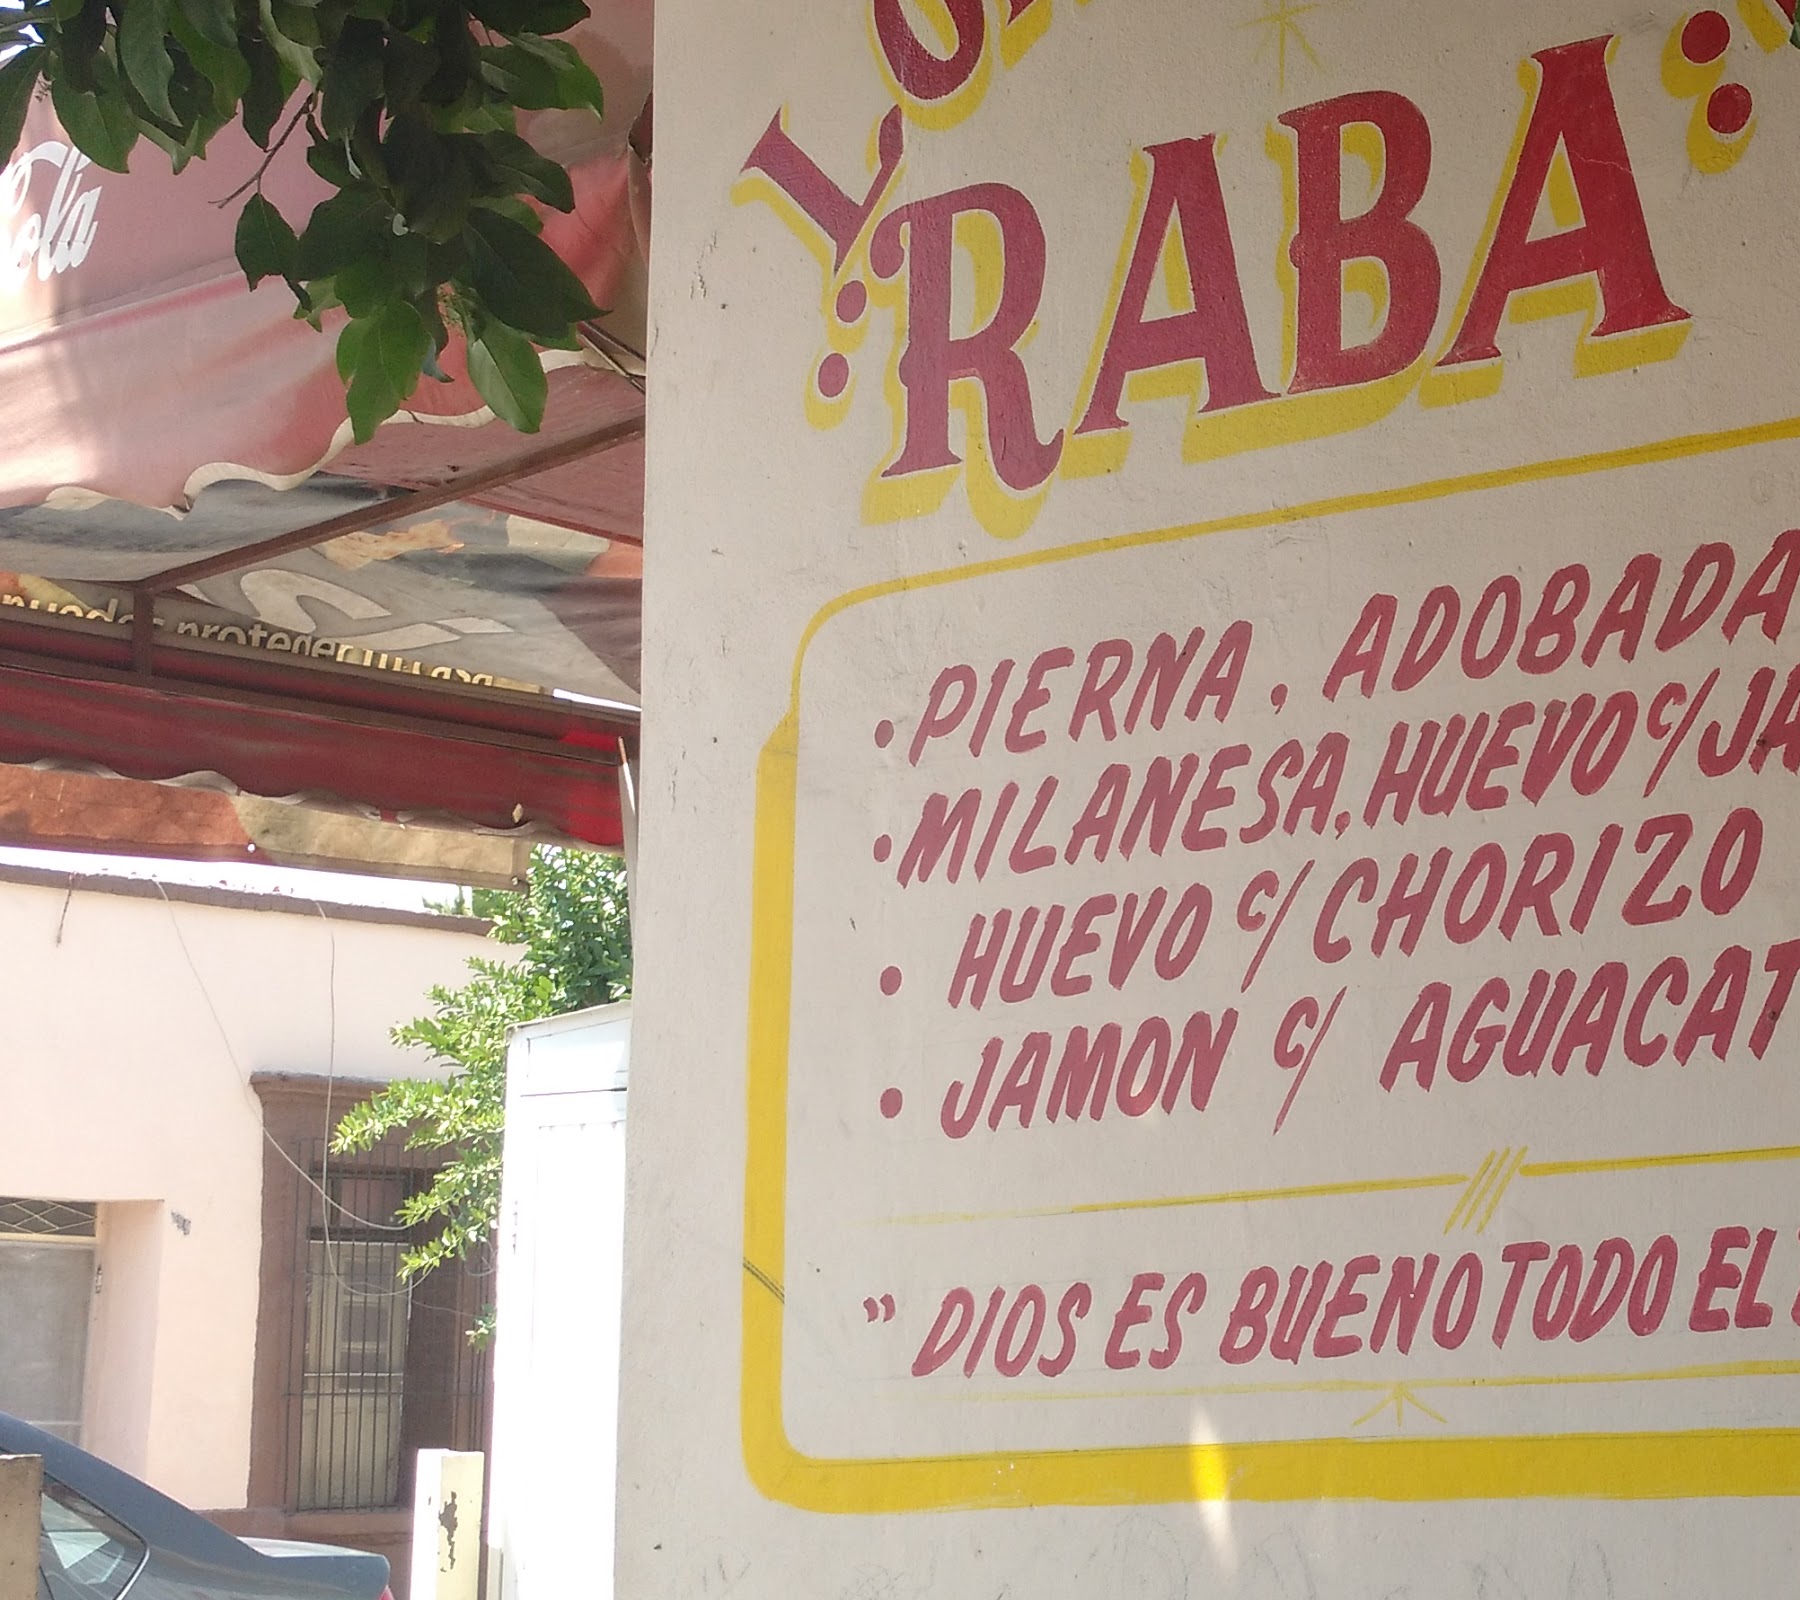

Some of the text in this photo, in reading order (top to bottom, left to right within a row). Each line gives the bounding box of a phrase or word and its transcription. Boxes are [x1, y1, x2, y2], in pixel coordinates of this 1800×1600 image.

[870, 34, 1692, 491] RABA
[1364, 691, 1636, 829] HUEVO
[948, 883, 1212, 1010] HUEVO
[1312, 807, 1763, 963] CHORIZO
[940, 1008, 1238, 1138] JAMON
[1105, 1272, 1207, 1370] ES
[1220, 1252, 1483, 1364] BUENO
[1492, 1235, 1678, 1350] TODO
[1689, 1226, 1777, 1333] EL
